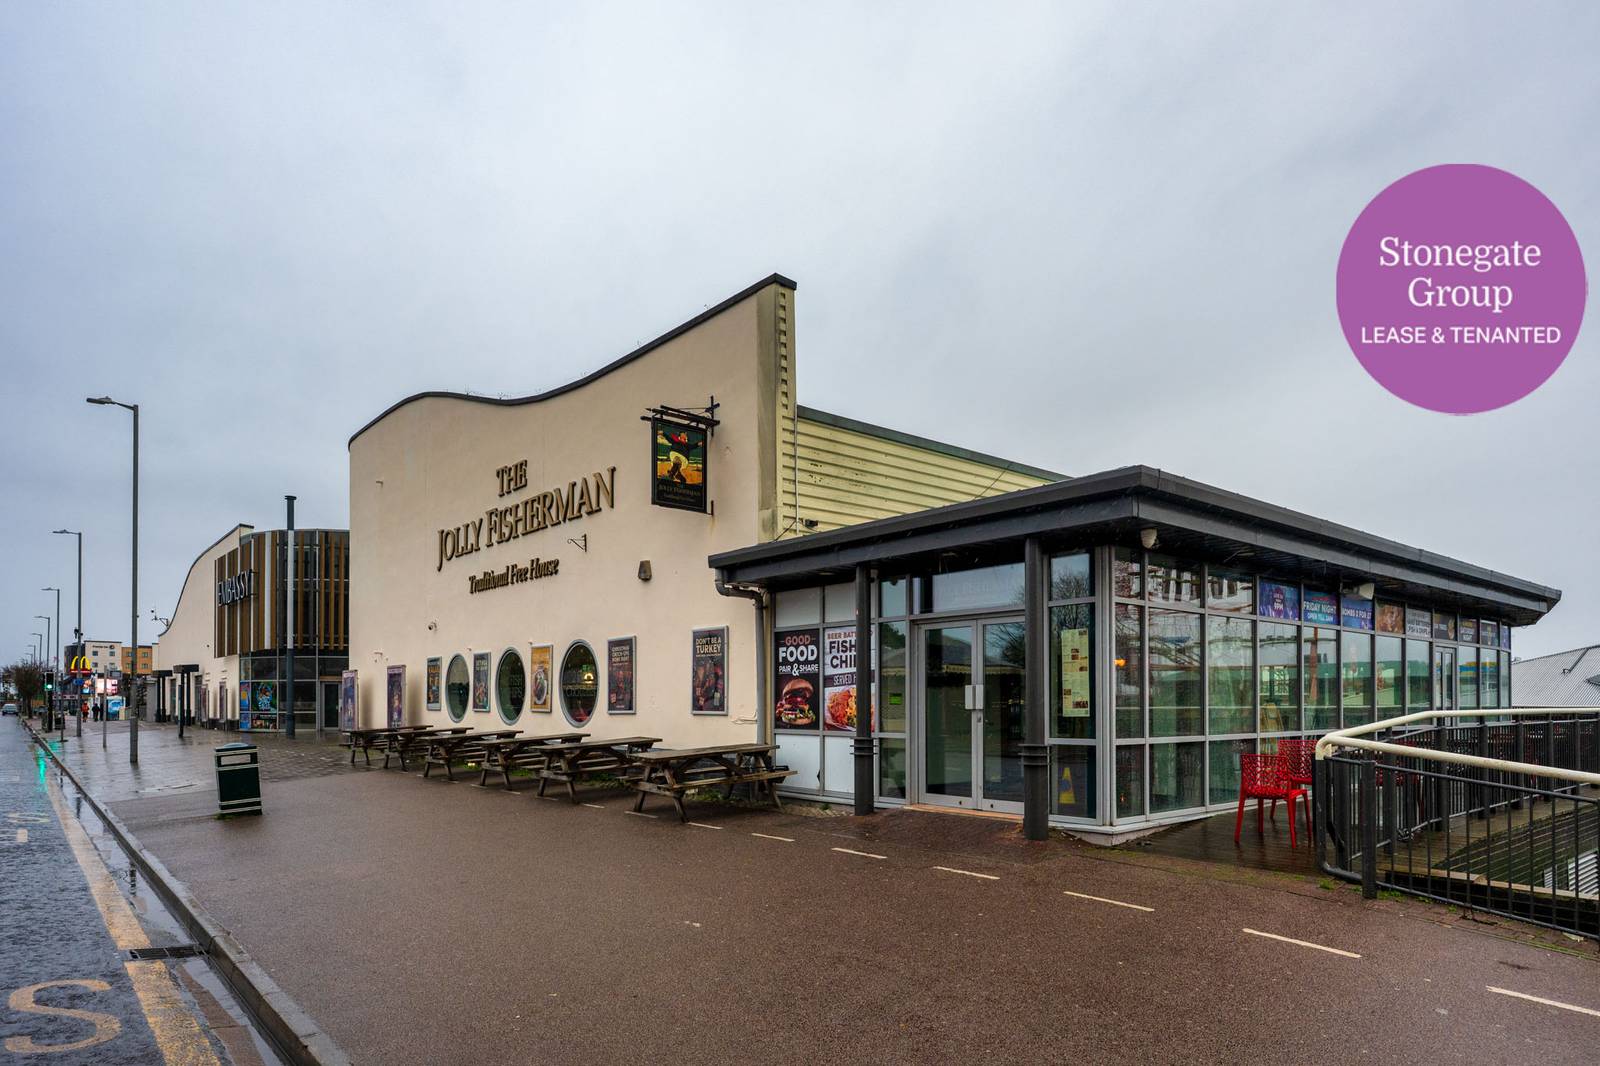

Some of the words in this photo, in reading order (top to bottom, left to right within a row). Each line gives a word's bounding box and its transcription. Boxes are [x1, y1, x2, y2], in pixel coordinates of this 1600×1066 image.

[495, 459, 528, 497] THE
[437, 517, 483, 572] JOLLY
[485, 466, 616, 547] FISHERMAN
[510, 563, 529, 584] Free
[529, 557, 559, 581] House
[785, 635, 811, 646] GOOD
[695, 644, 722, 654] TURKEY
[779, 644, 818, 663] FOOD
[830, 655, 857, 669] CHI
[779, 665, 792, 673] PAIR
[792, 663, 800, 676] &
[799, 664, 819, 672] SHARE
[833, 674, 853, 686] SERVED
